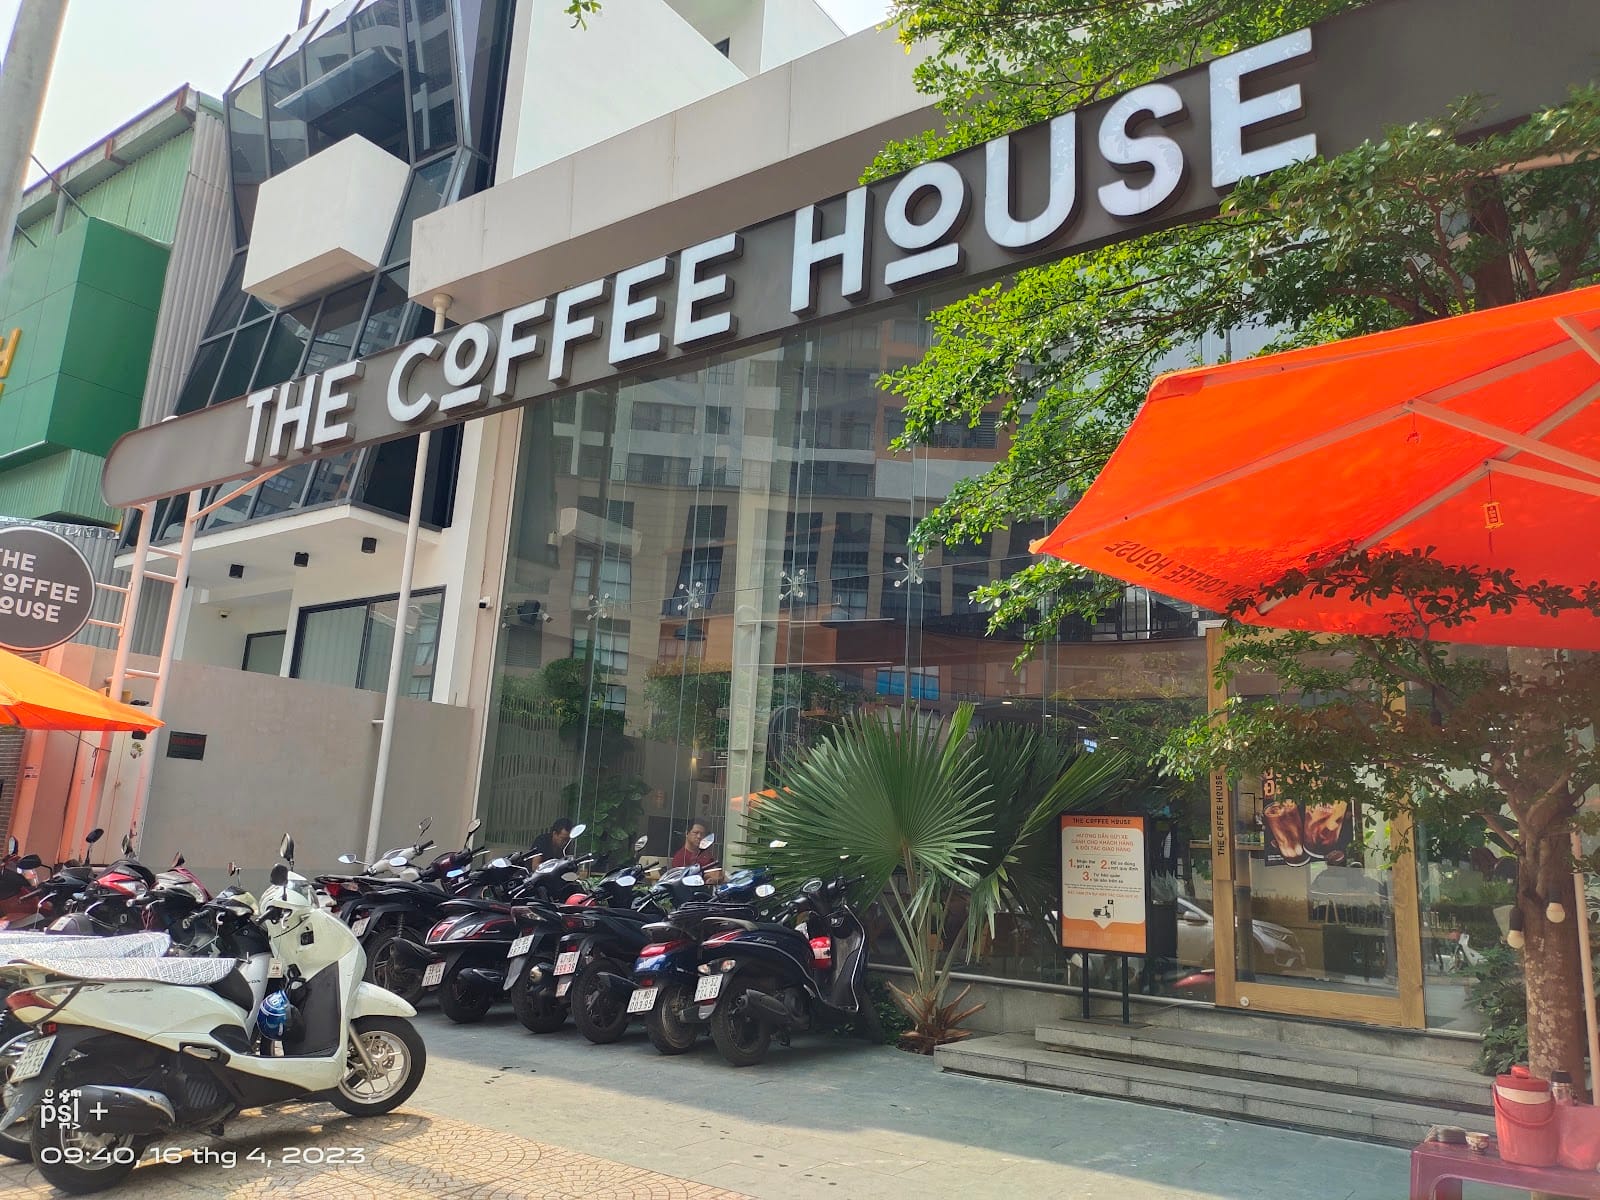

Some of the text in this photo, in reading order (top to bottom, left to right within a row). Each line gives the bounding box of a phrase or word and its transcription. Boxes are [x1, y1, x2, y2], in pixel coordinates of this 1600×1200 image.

[245, 359, 364, 465] THE
[0, 548, 37, 572] HE
[0, 573, 80, 604] OFFEE
[0, 596, 61, 623] OUSE
[1215, 775, 1225, 856] THE COFFEE HOUSE
